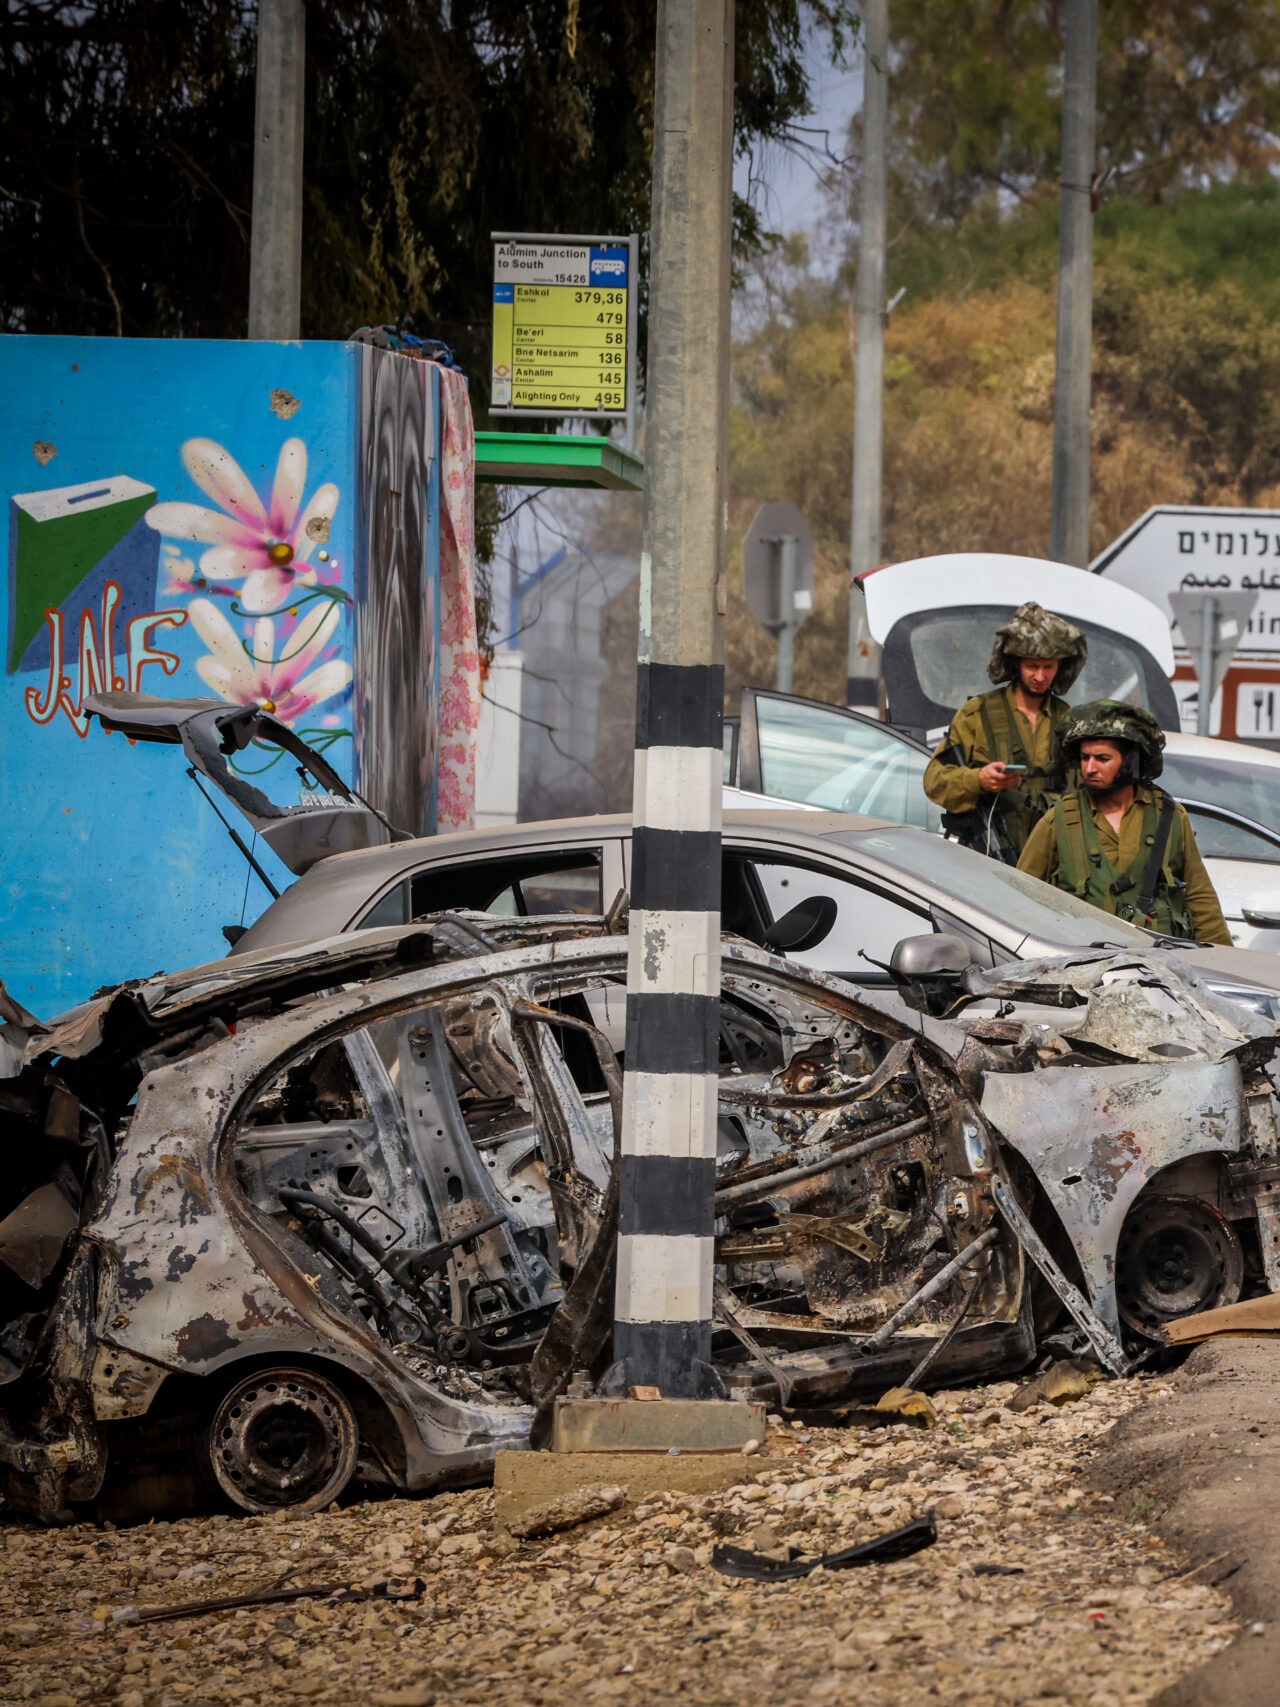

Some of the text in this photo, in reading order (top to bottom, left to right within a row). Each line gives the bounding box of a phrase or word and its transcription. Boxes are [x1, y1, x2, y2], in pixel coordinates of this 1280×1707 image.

[498, 247, 586, 258] Alumim Junction
[498, 259, 544, 269] to South
[555, 274, 586, 283] 15426
[517, 287, 549, 297] Eshkol
[575, 291, 623, 305] 379,36
[596, 312, 623, 325] 479
[516, 327, 544, 337] Be'eri
[605, 332, 623, 344] 58
[515, 348, 579, 358] Bne Netsarim
[599, 352, 622, 364] 136
[516, 368, 553, 377] Ashalim
[598, 373, 622, 385] 145
[515, 391, 581, 403] Alighting Only
[595, 393, 621, 404] 495
